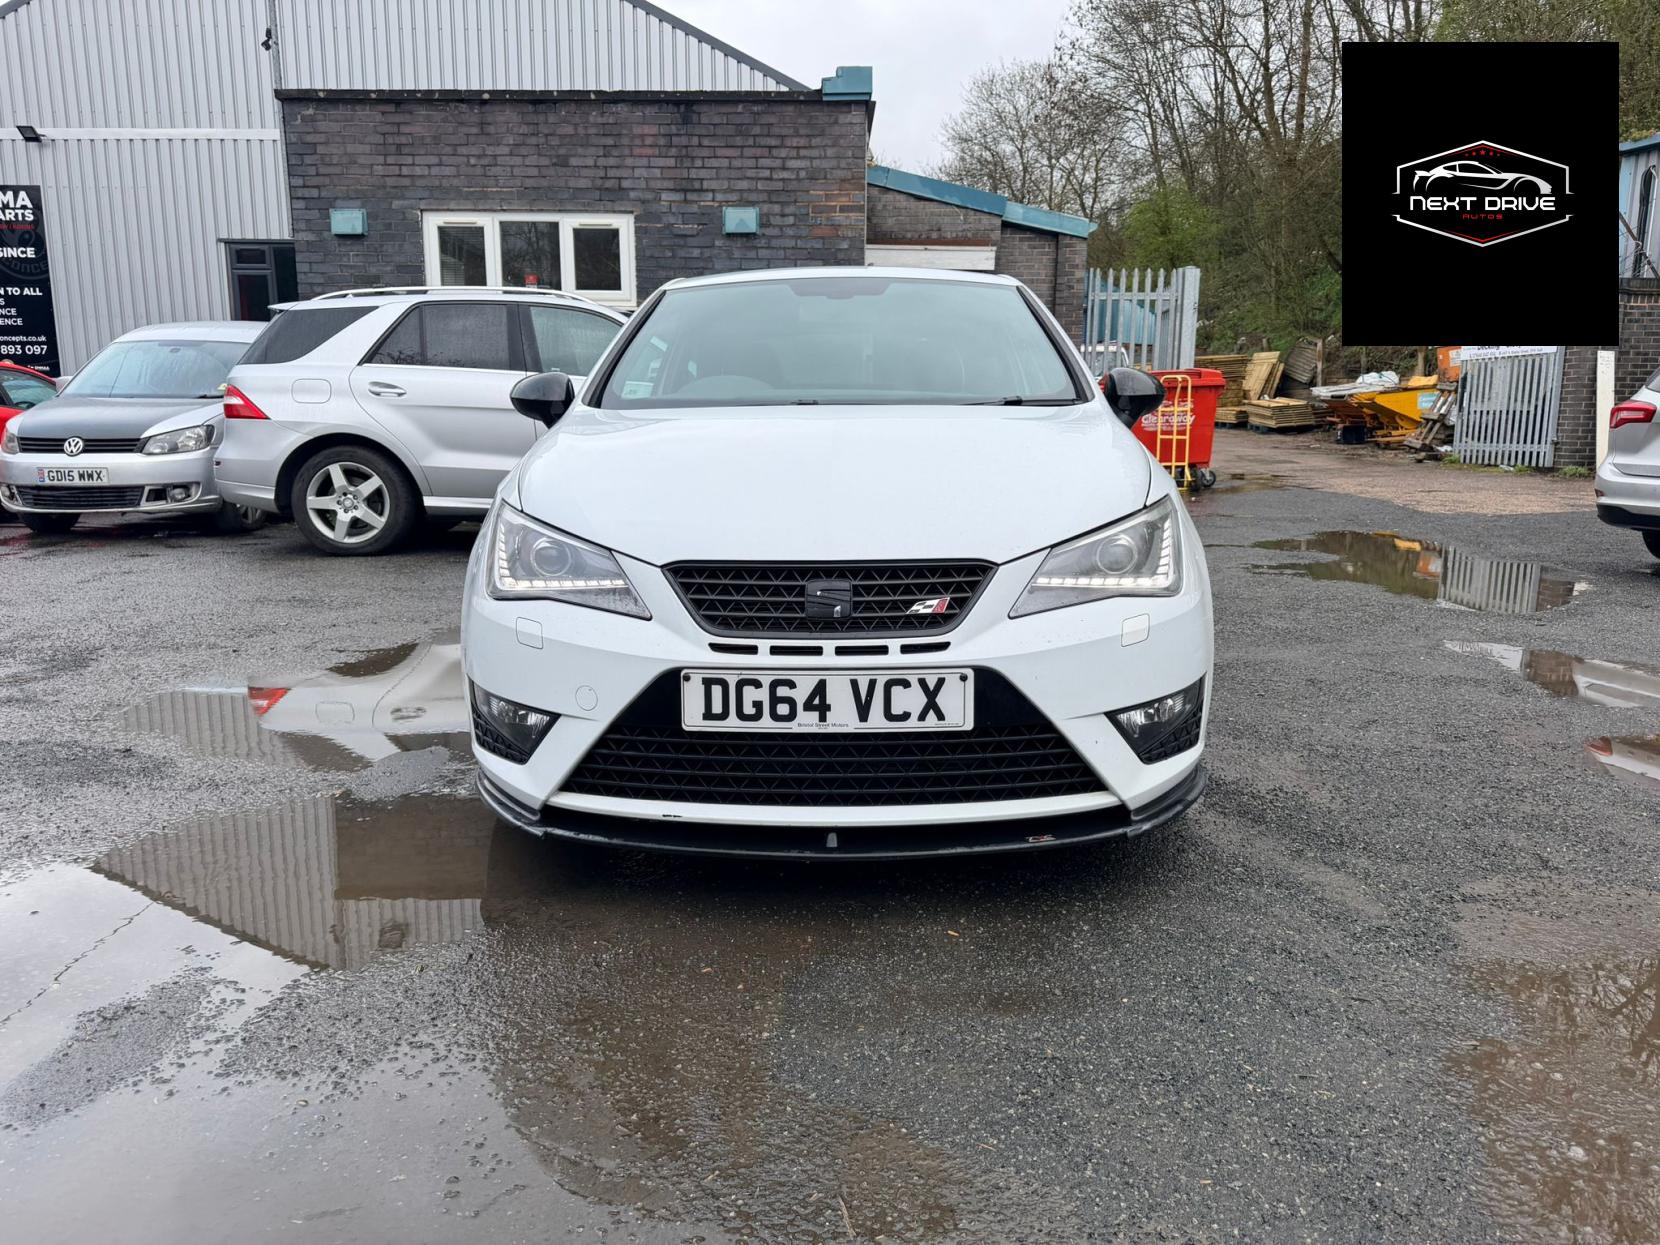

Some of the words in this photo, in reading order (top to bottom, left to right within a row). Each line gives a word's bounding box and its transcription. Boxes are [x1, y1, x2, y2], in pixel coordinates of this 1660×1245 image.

[0, 191, 33, 208] MA
[6, 287, 21, 296] TO
[23, 287, 43, 296] ALL
[0, 345, 22, 354] 893
[25, 345, 48, 354] 097
[47, 470, 75, 482] GD15
[78, 470, 103, 482] WWX
[702, 677, 831, 722] DG64
[850, 677, 946, 722] VCX
